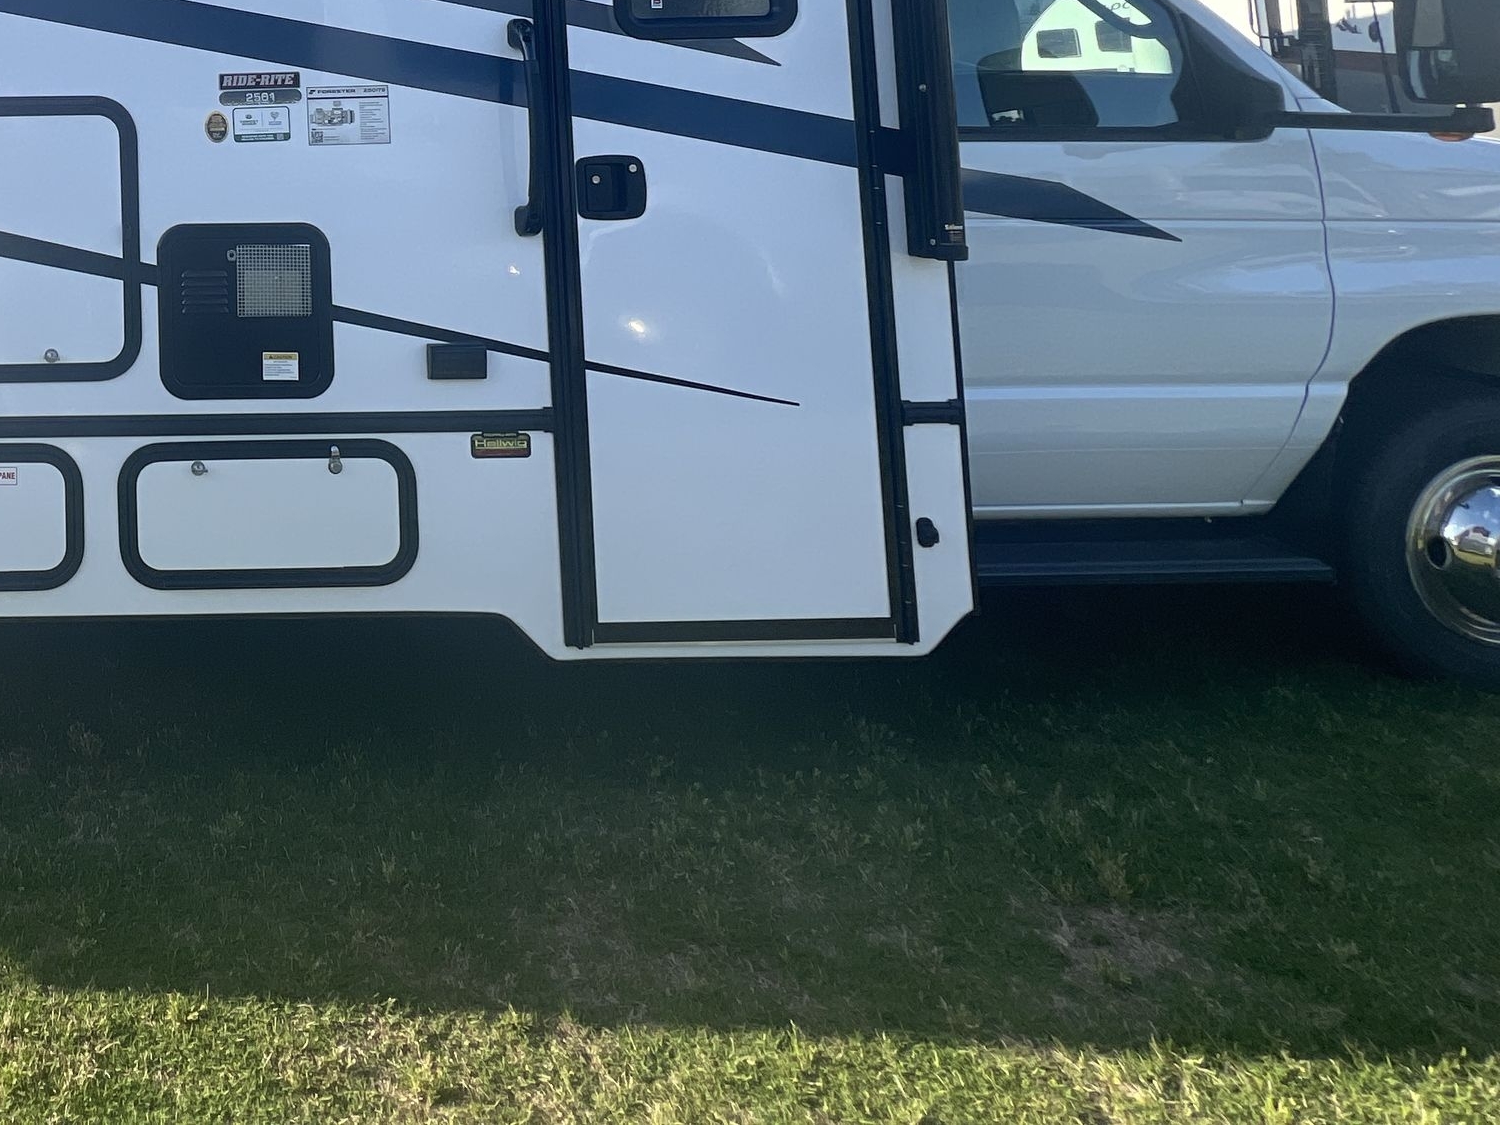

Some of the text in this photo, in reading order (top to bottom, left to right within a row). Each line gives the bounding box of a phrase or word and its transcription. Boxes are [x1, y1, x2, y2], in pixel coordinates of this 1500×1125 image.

[222, 74, 295, 87] RIDE-RITE
[245, 92, 276, 103] 2501
[475, 438, 528, 449] Hellwig
